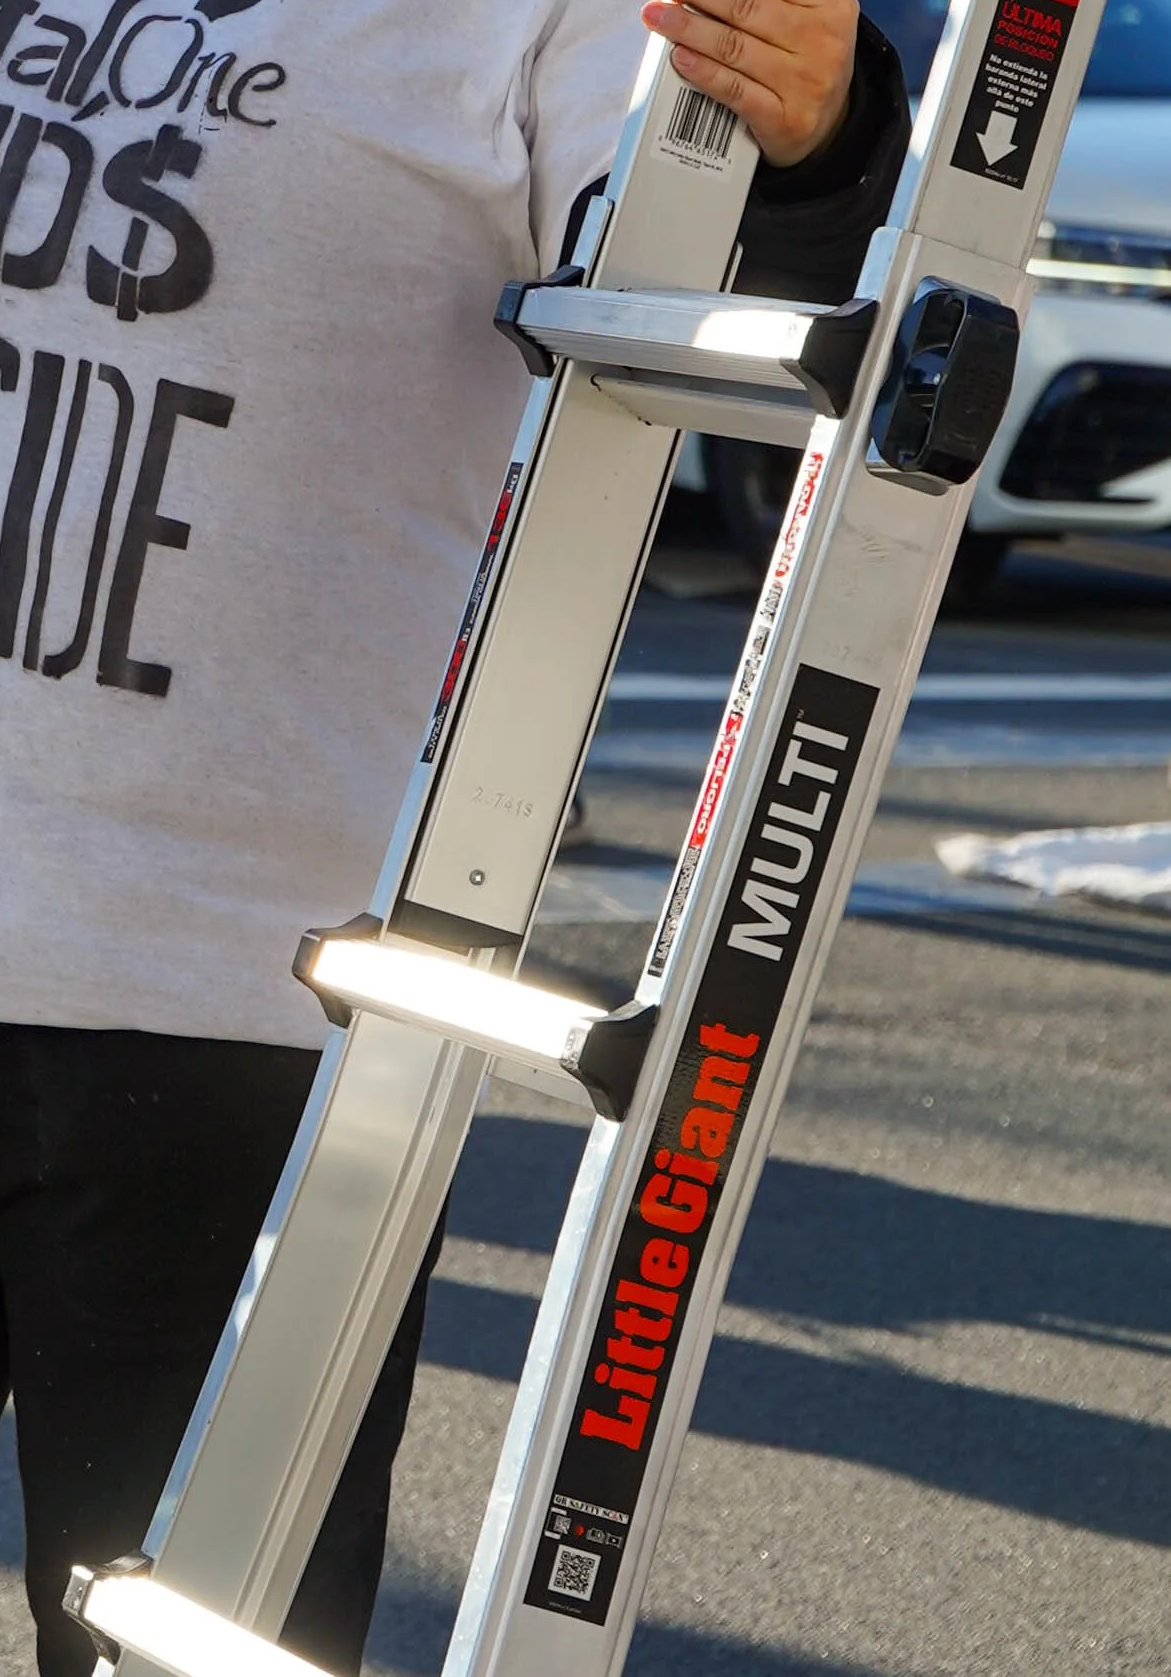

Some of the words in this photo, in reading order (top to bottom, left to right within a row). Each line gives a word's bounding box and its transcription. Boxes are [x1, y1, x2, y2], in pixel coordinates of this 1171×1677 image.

[984, 63, 1019, 80] baranda
[1019, 74, 1047, 90] lateral
[989, 53, 1002, 64] No
[1002, 58, 1038, 76] extienda
[1038, 70, 1048, 80] la
[987, 74, 1020, 91] externa
[994, 98, 1020, 113] punto
[1002, 90, 1015, 101] de
[1014, 95, 1034, 107] este
[695, 743, 730, 835] PELIGRO
